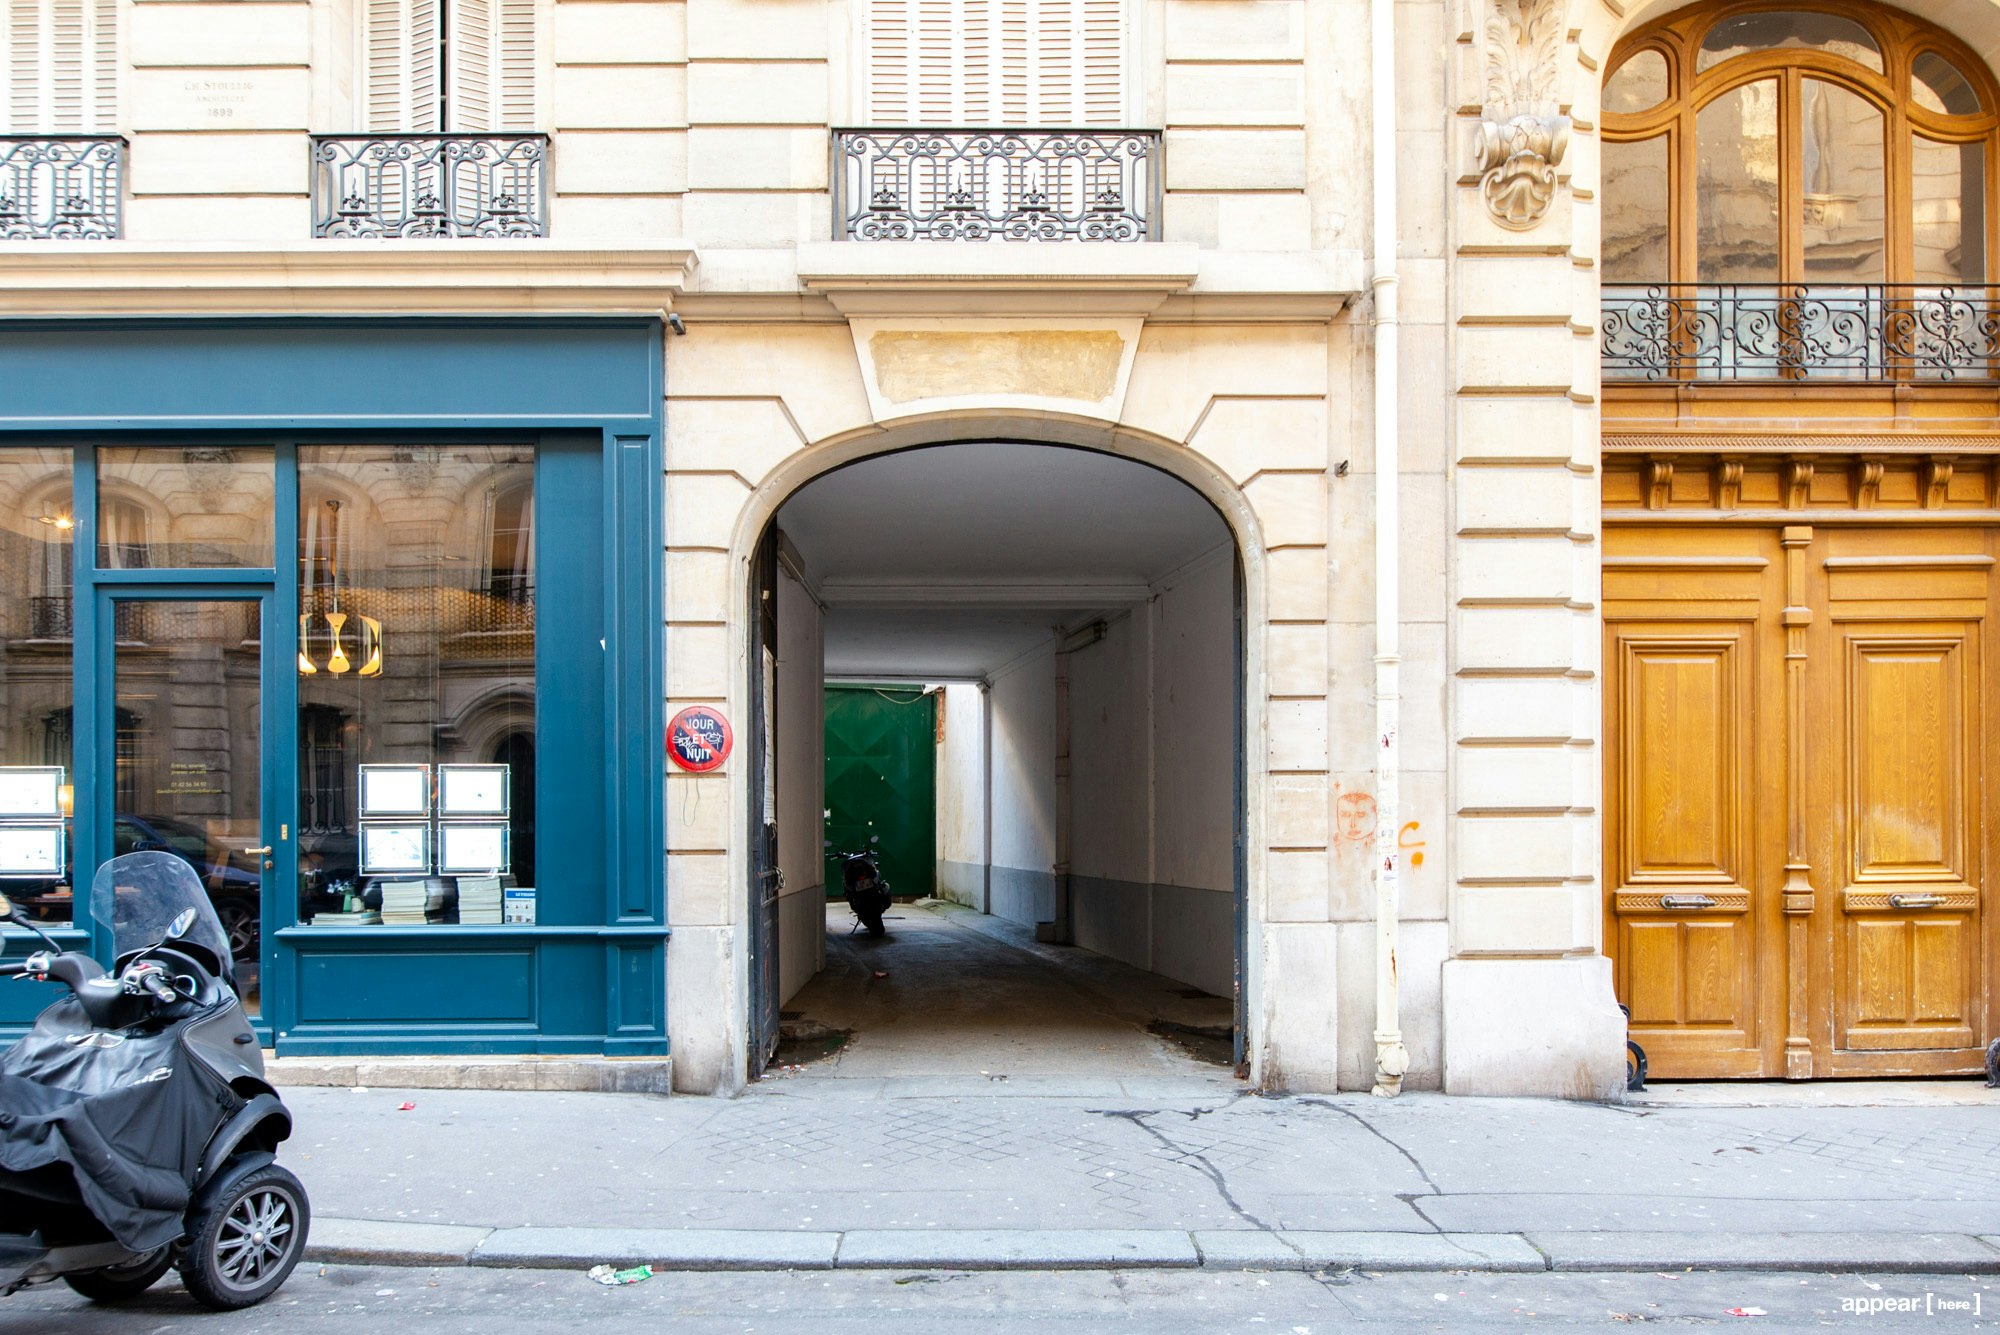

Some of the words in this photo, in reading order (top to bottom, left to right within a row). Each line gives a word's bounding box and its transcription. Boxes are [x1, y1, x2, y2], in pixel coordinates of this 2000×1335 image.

[208, 108, 233, 117] 1899
[686, 718, 714, 730] JOUR
[692, 733, 706, 745] ET
[686, 748, 712, 760] NUIT
